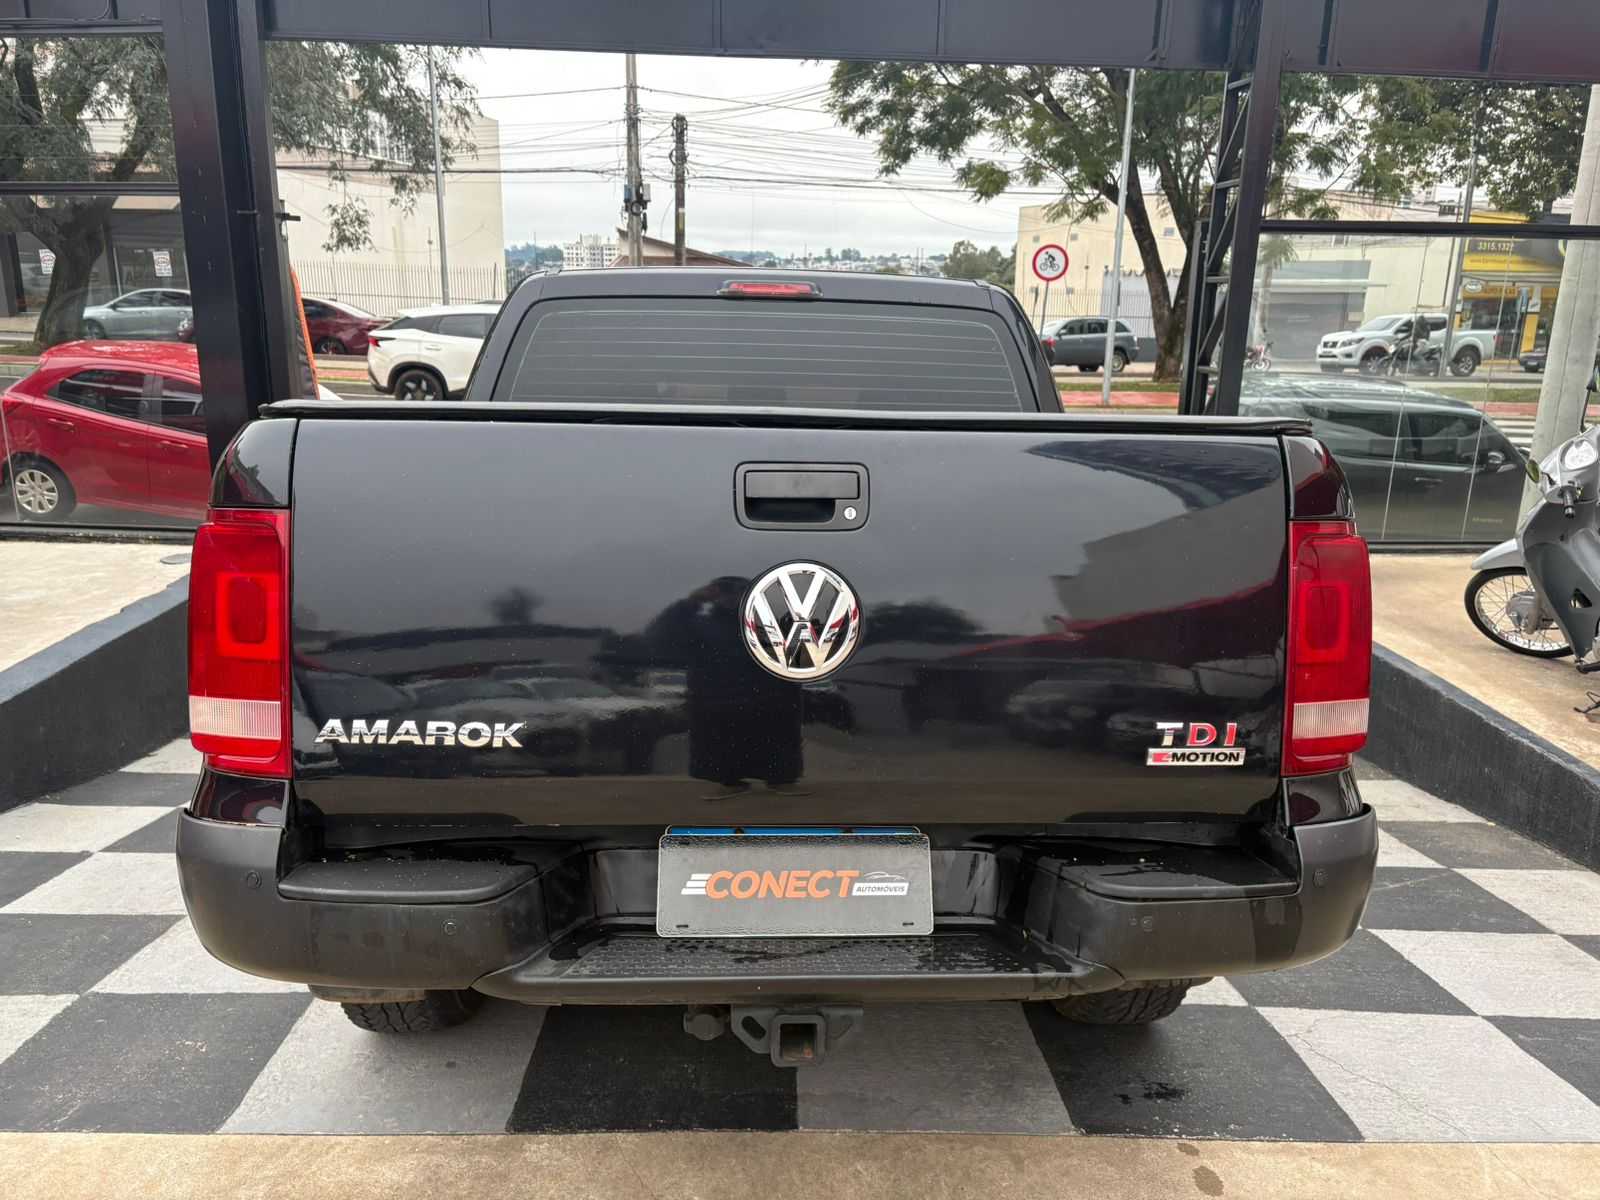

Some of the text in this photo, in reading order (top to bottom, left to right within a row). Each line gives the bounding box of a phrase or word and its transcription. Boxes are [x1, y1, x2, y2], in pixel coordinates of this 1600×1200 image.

[314, 718, 525, 748] AMAROK
[1155, 721, 1238, 747] TDI
[705, 869, 906, 900] CONECT AUTOMÓVEIS
